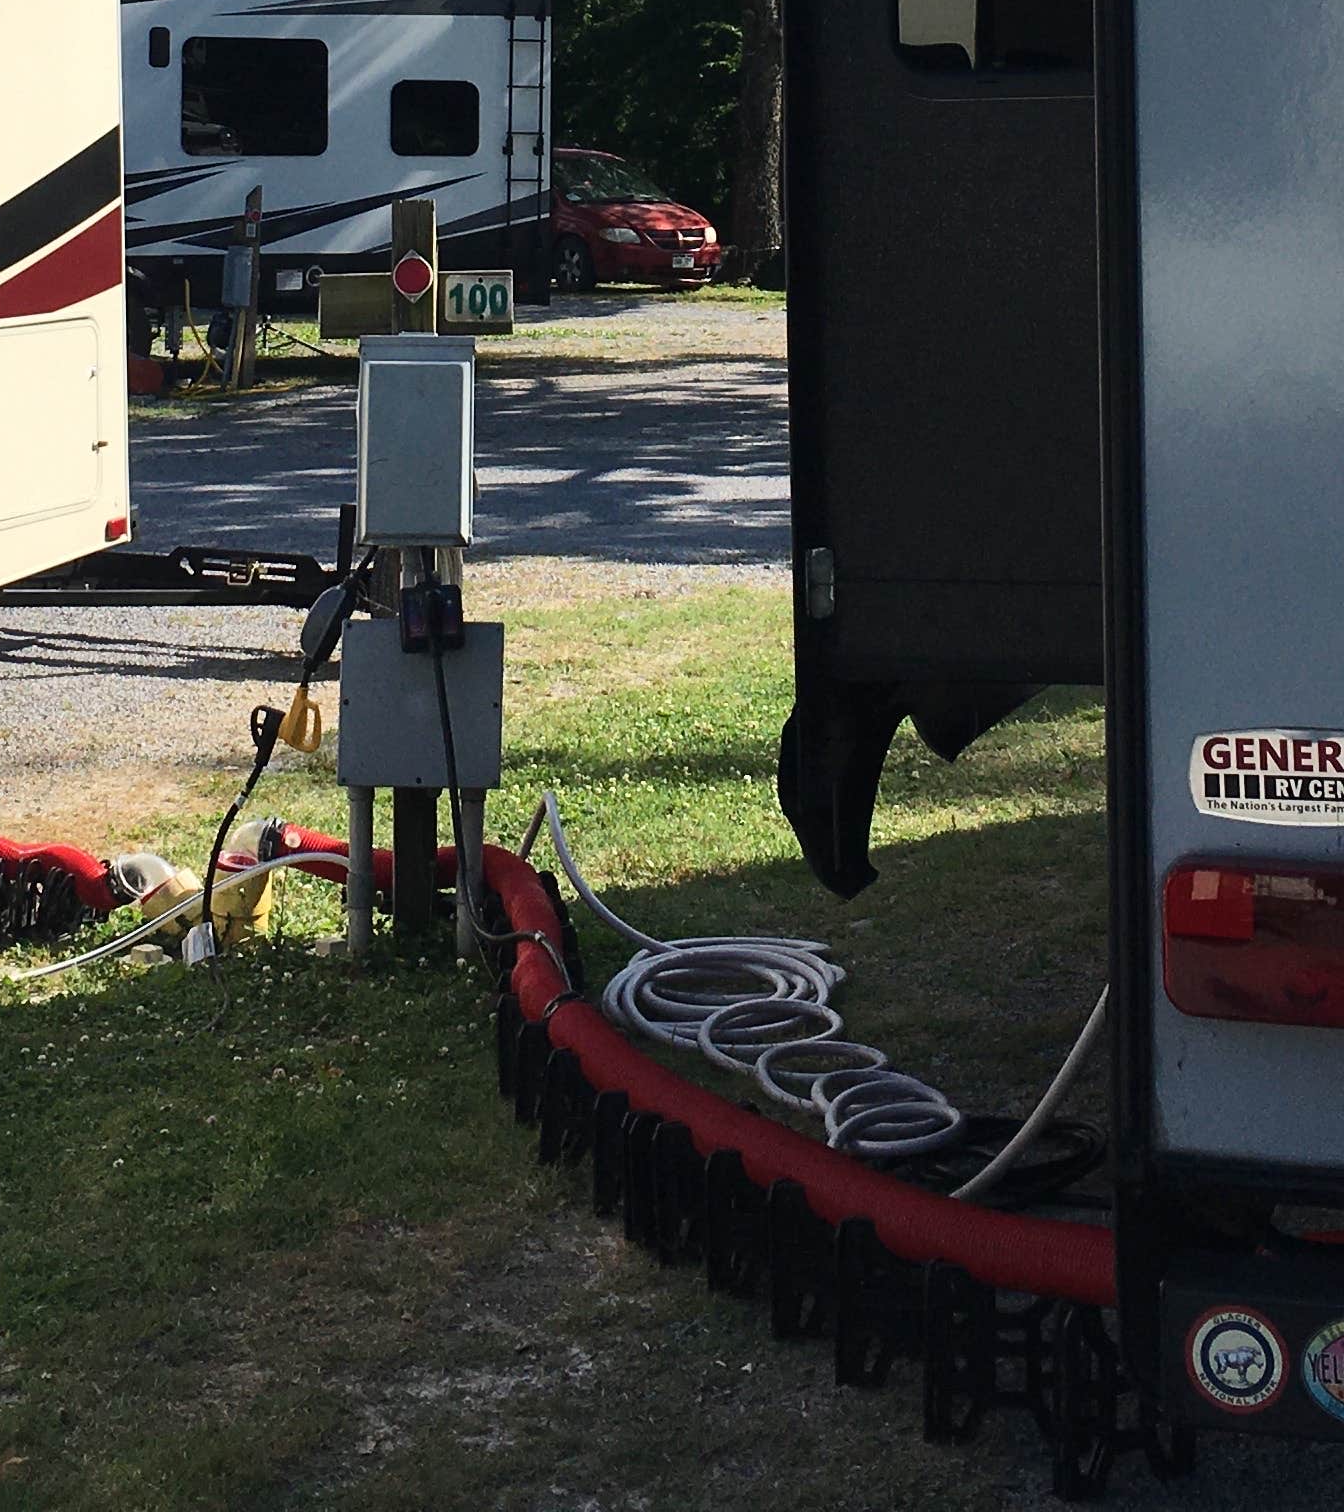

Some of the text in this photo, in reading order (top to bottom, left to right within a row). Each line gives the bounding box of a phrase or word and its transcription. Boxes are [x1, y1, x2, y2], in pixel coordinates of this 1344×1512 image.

[449, 282, 508, 316] 100
[1275, 778, 1304, 799] RV
[1207, 800, 1227, 810] The
[1230, 800, 1276, 812] Nation's
[1278, 802, 1321, 814] Largest
[1199, 1372, 1278, 1405] NATIONAL PARK
